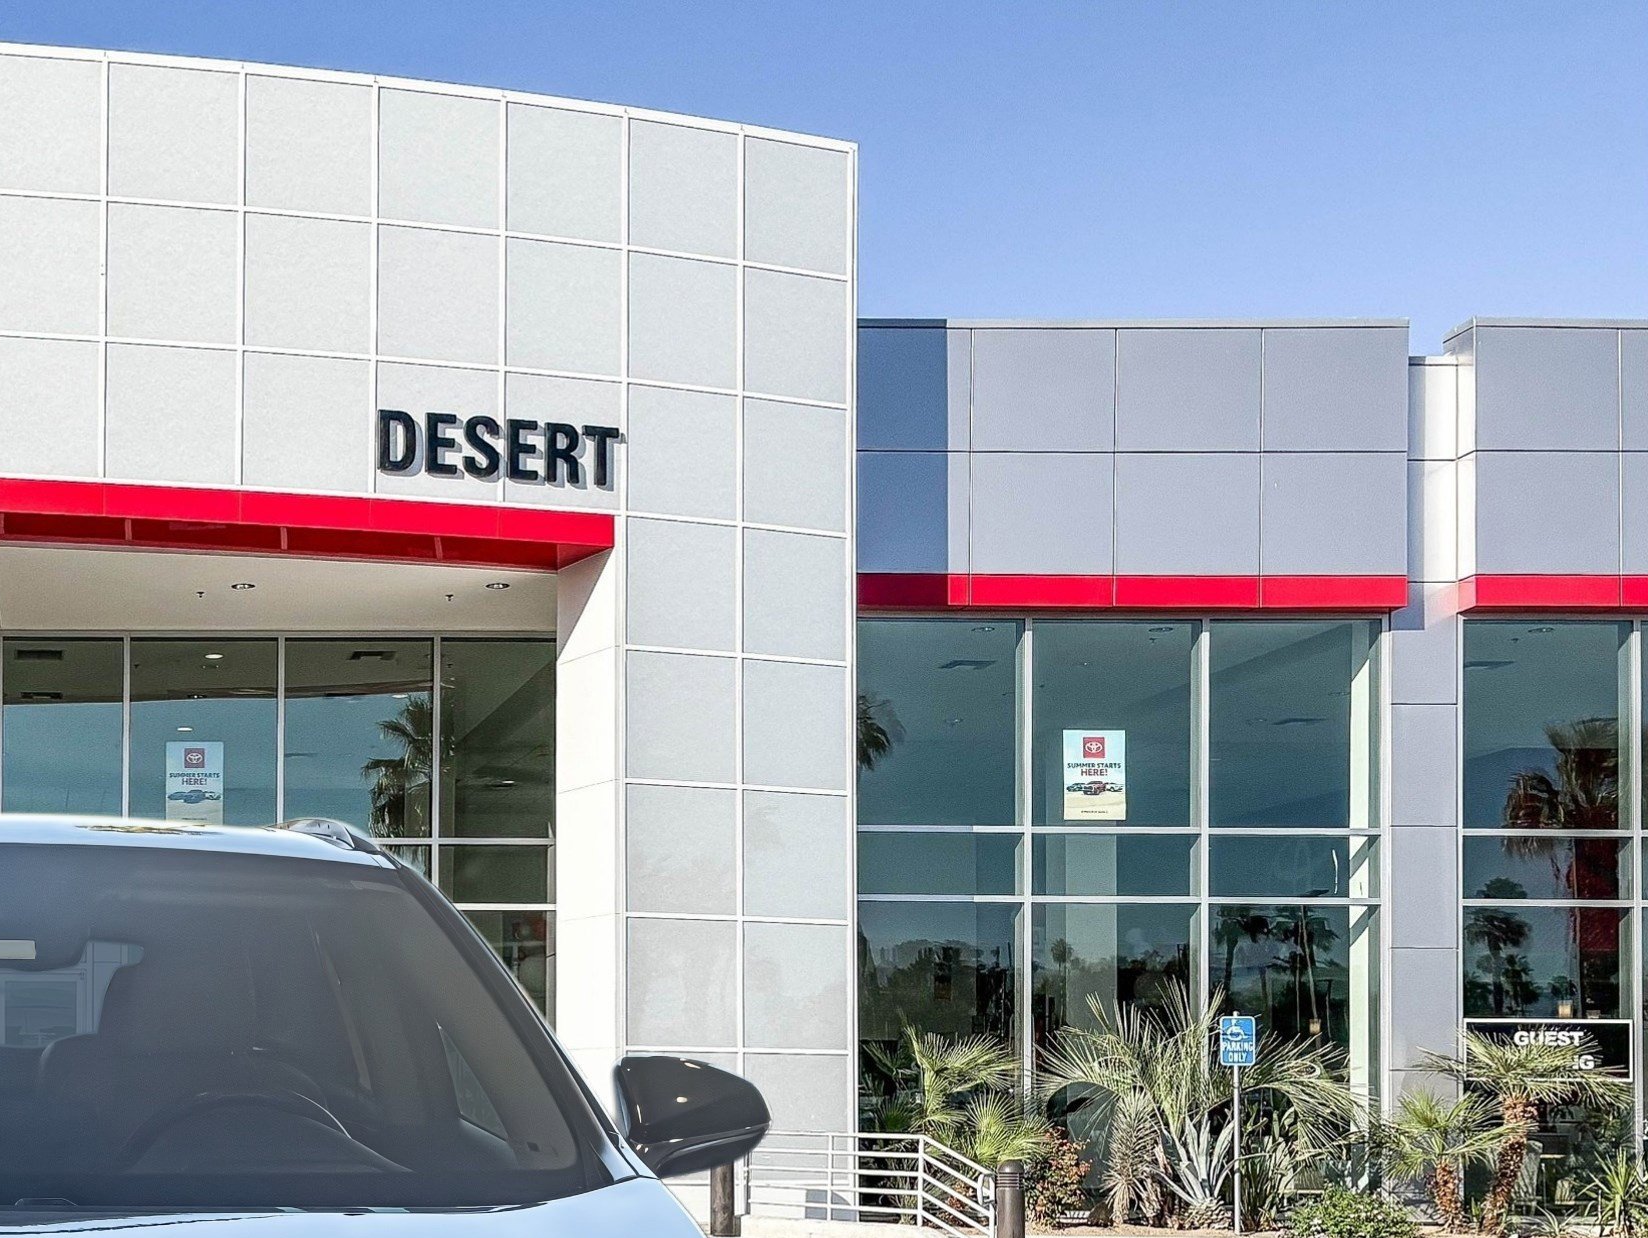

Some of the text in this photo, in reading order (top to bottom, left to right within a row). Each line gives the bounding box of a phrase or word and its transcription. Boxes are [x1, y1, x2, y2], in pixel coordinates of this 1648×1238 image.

[377, 409, 620, 487] DESERT
[1080, 768, 1108, 776] HERE!
[181, 778, 207, 786] HERE!
[1513, 1031, 1584, 1047] GUEST
[1222, 1041, 1253, 1051] PARKING
[1228, 1051, 1247, 1062] ONLY
